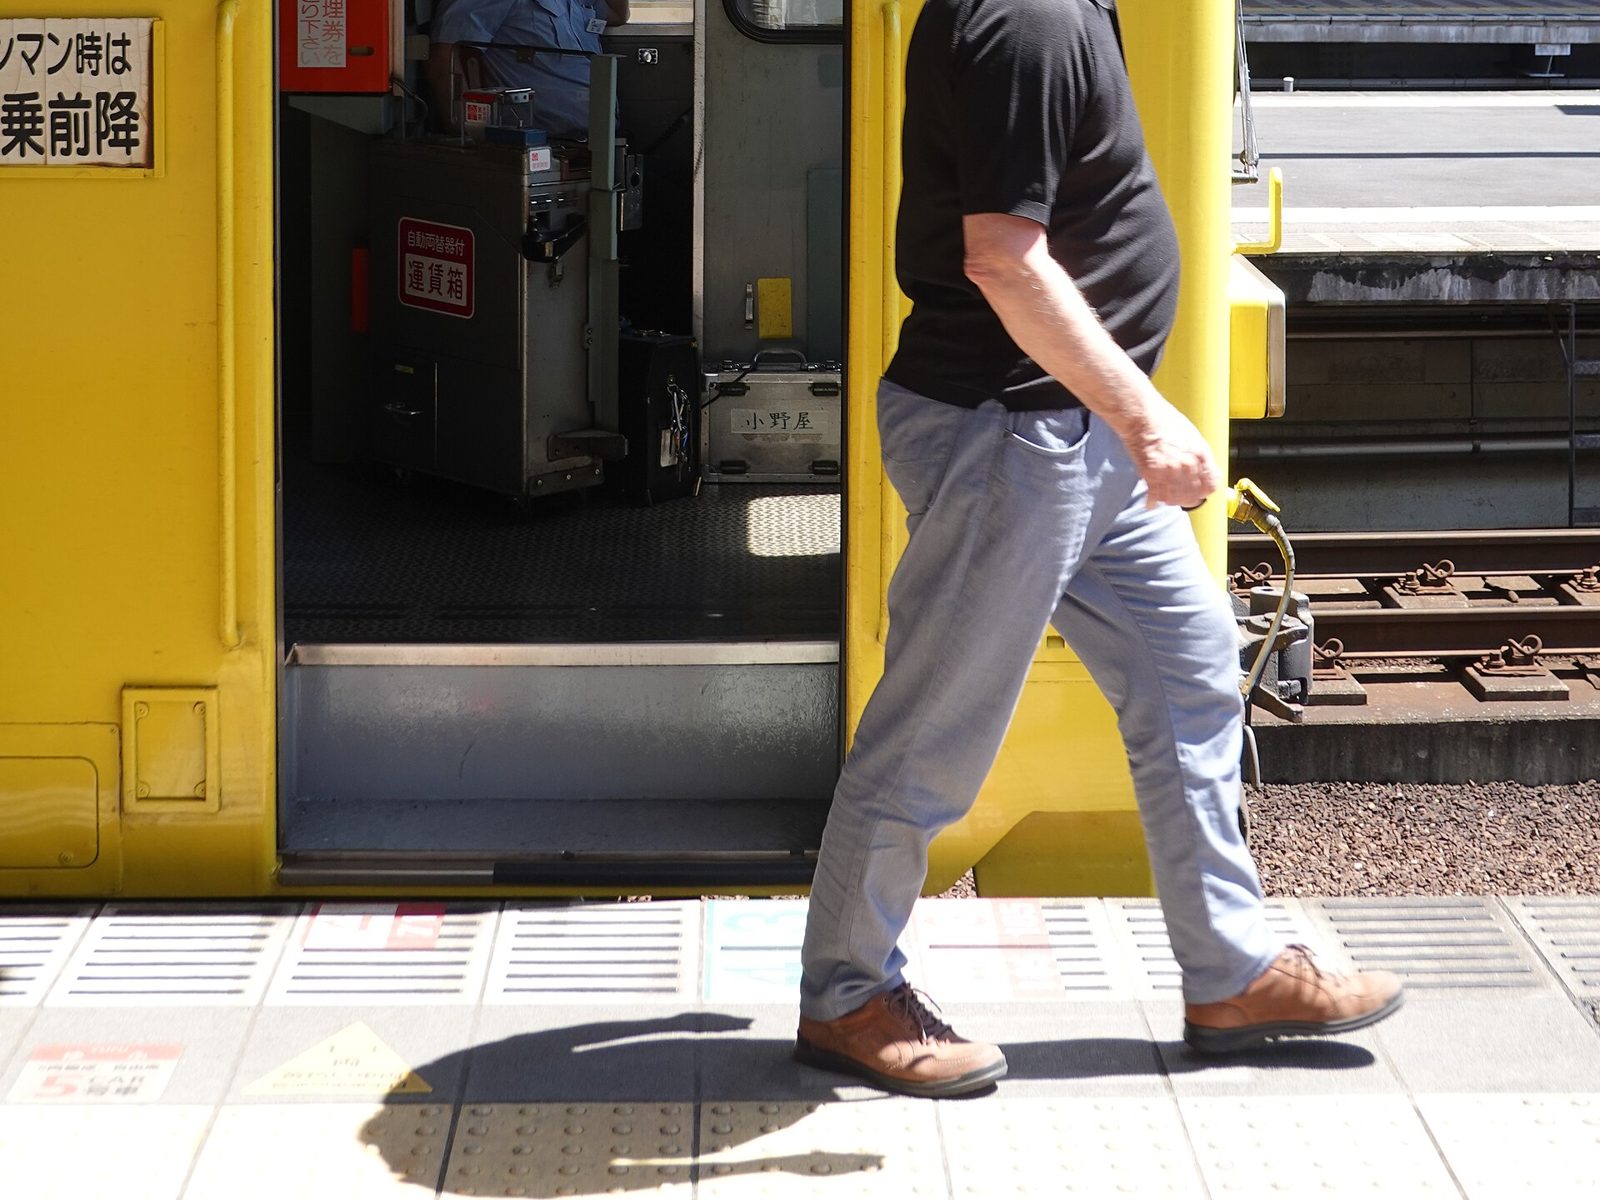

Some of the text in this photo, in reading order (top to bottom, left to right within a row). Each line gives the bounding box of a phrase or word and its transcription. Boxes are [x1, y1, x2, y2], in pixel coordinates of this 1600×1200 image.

[1, 91, 140, 158] 乗前降
[407, 230, 465, 257] 自動両替器付
[408, 260, 464, 301] 運賃箱
[746, 411, 814, 431] 小野屋
